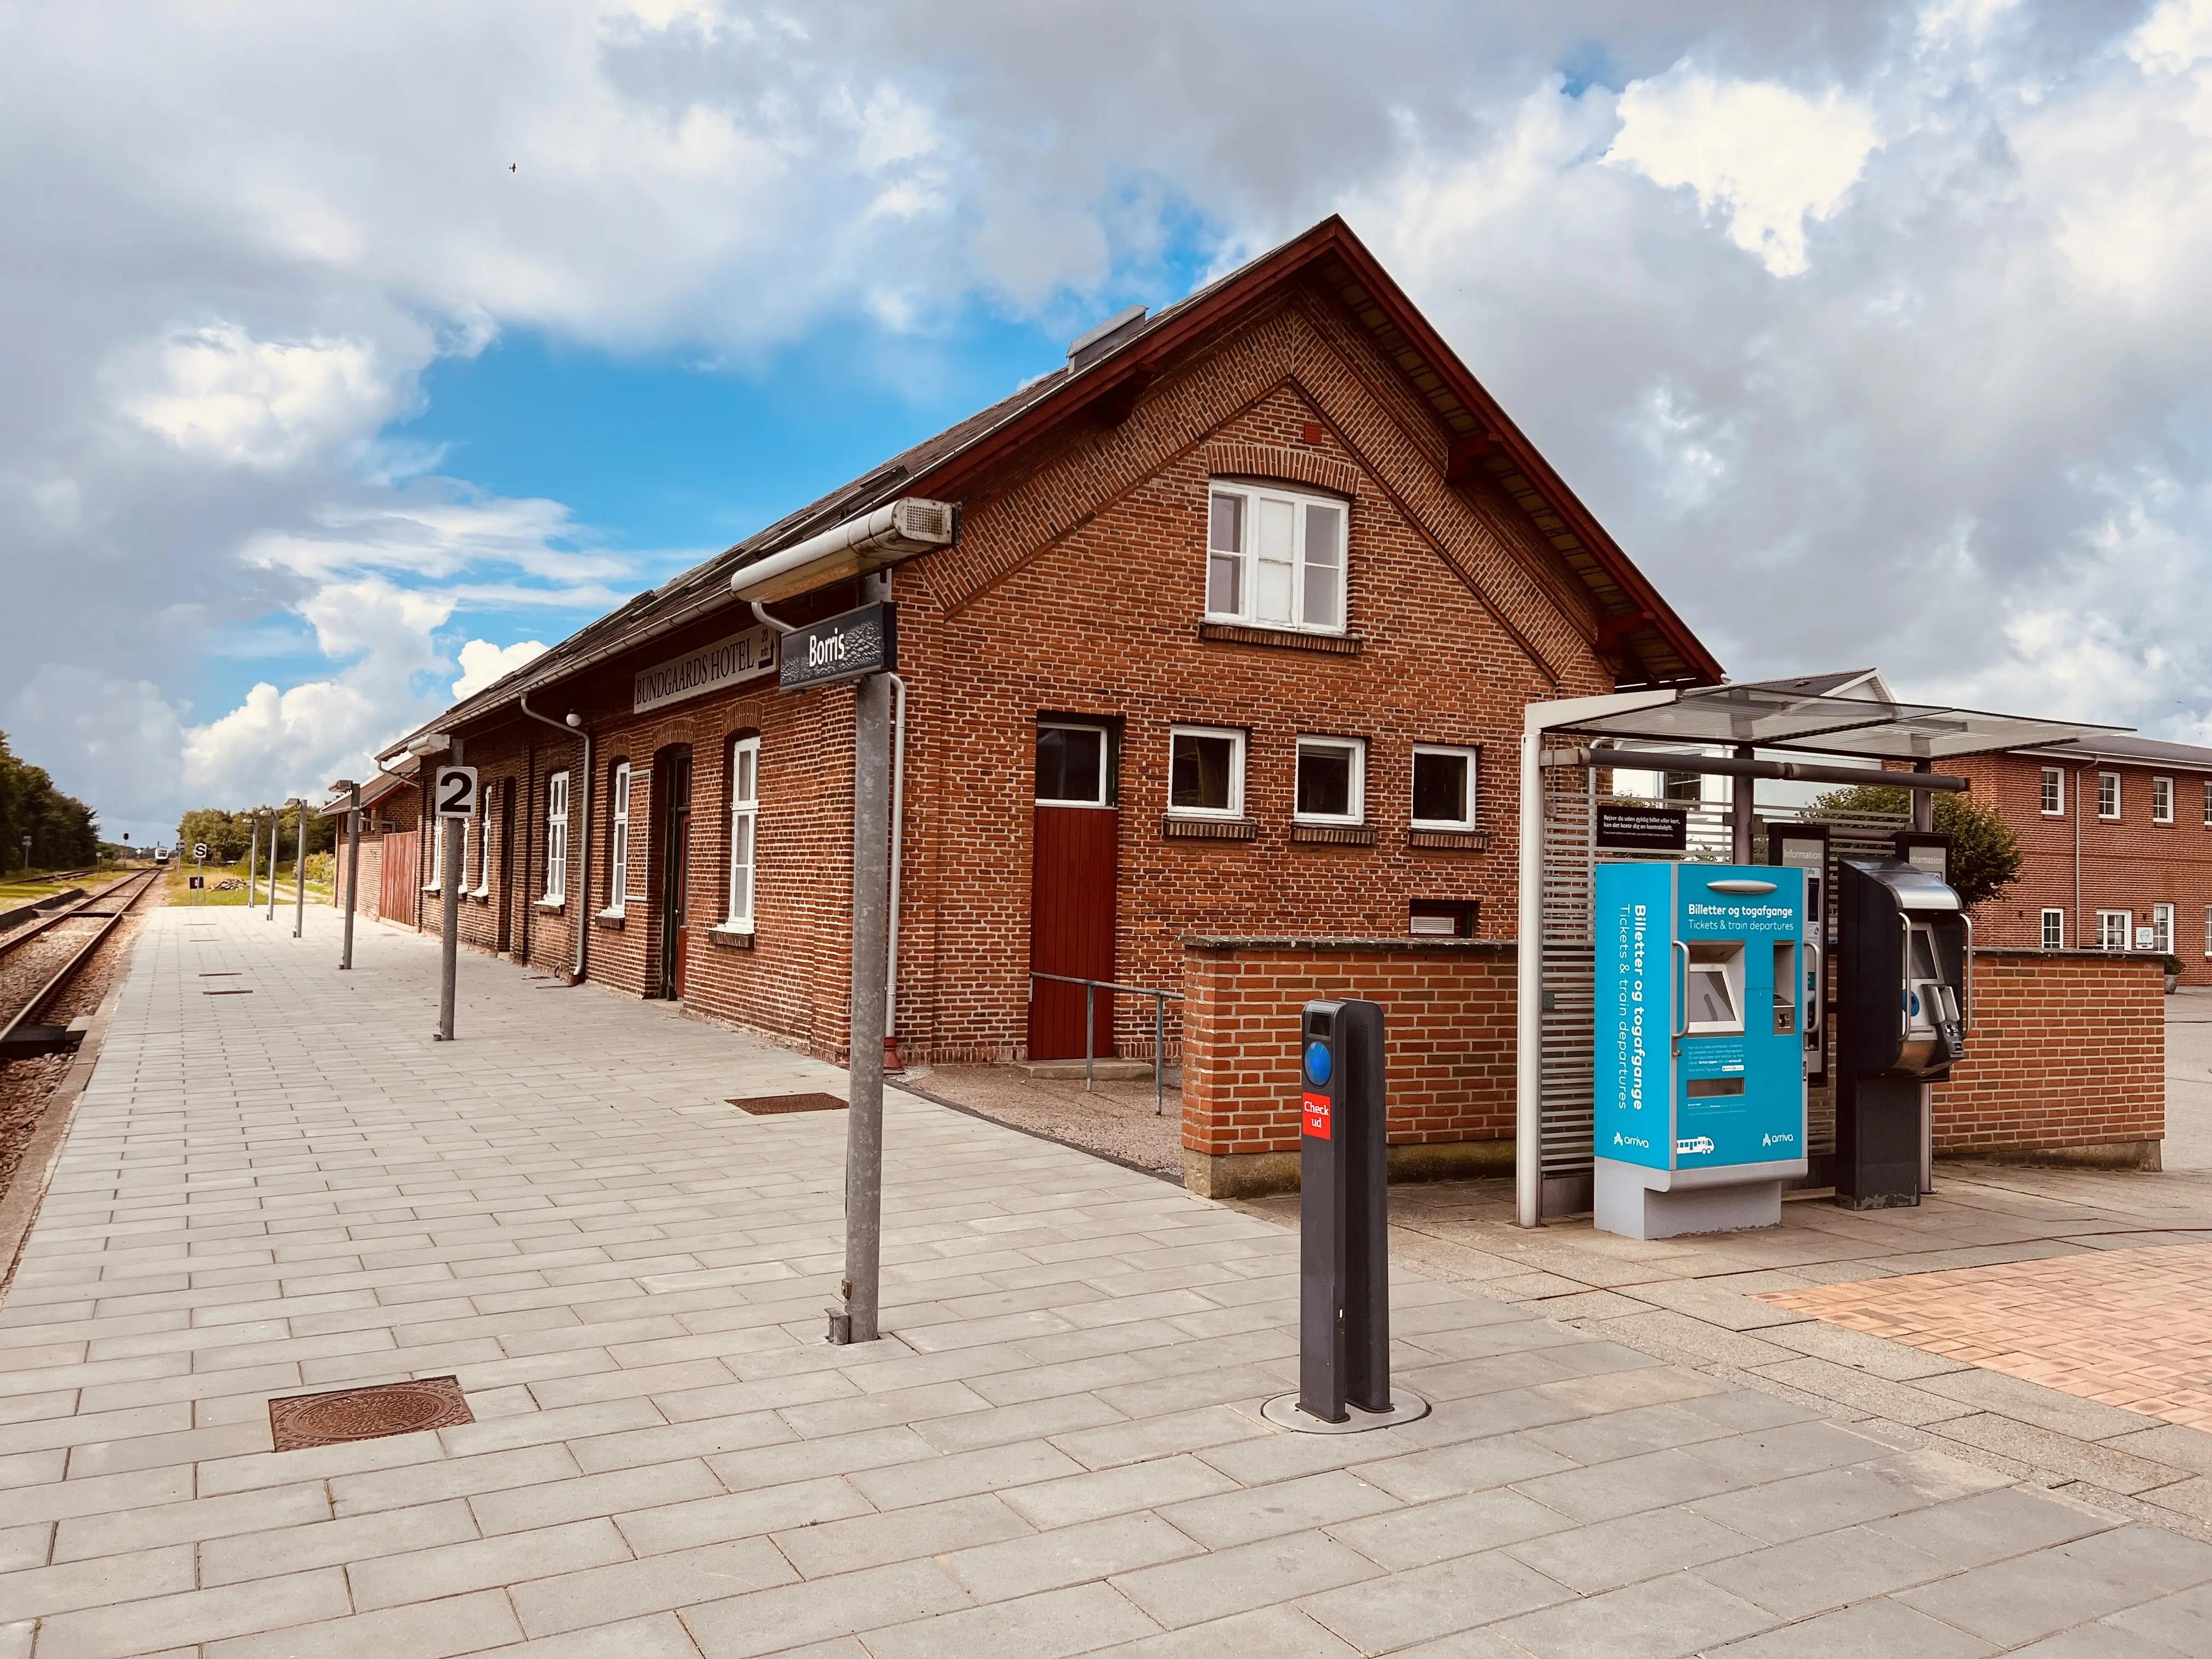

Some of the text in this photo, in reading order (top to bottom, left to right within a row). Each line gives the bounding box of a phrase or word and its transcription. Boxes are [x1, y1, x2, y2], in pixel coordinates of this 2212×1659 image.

[762, 628, 768, 643] 20
[809, 627, 844, 667] Borris
[636, 637, 754, 705] BUNDGAARDS HOTEL
[440, 771, 472, 812] 2
[195, 845, 205, 856] S
[1784, 849, 1822, 859] Information
[1910, 856, 1943, 864] nformation
[1688, 904, 1793, 918] Billetter og togafgange
[1688, 919, 1793, 932] Tickets & train departures
[1617, 904, 1630, 1109] Tickets & train departures
[1630, 905, 1646, 1110] Billetter og togafgange
[1304, 1101, 1329, 1116] Check
[1311, 1118, 1322, 1128] ud
[1624, 1136, 1649, 1148] arriva
[1771, 1132, 1793, 1143] arriva
